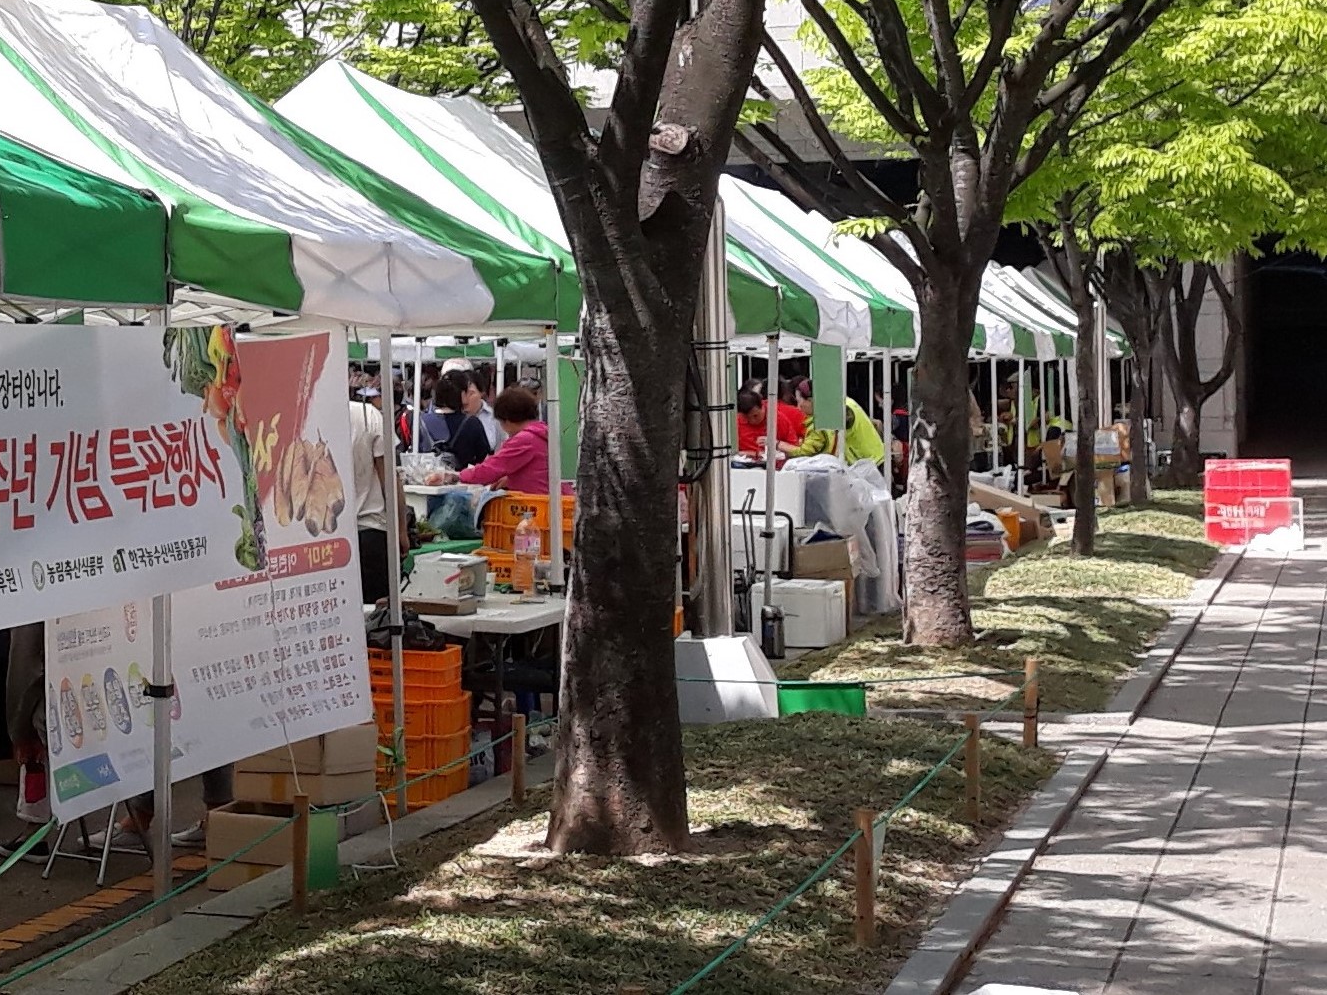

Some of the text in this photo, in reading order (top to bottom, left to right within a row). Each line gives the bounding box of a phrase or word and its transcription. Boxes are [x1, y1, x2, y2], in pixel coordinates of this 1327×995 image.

[46, 422, 112, 524] 기념
[109, 416, 226, 512] 특판행사
[46, 555, 105, 585] 농림축산식품부
[128, 536, 208, 570] 한국농수산식품유통공사
